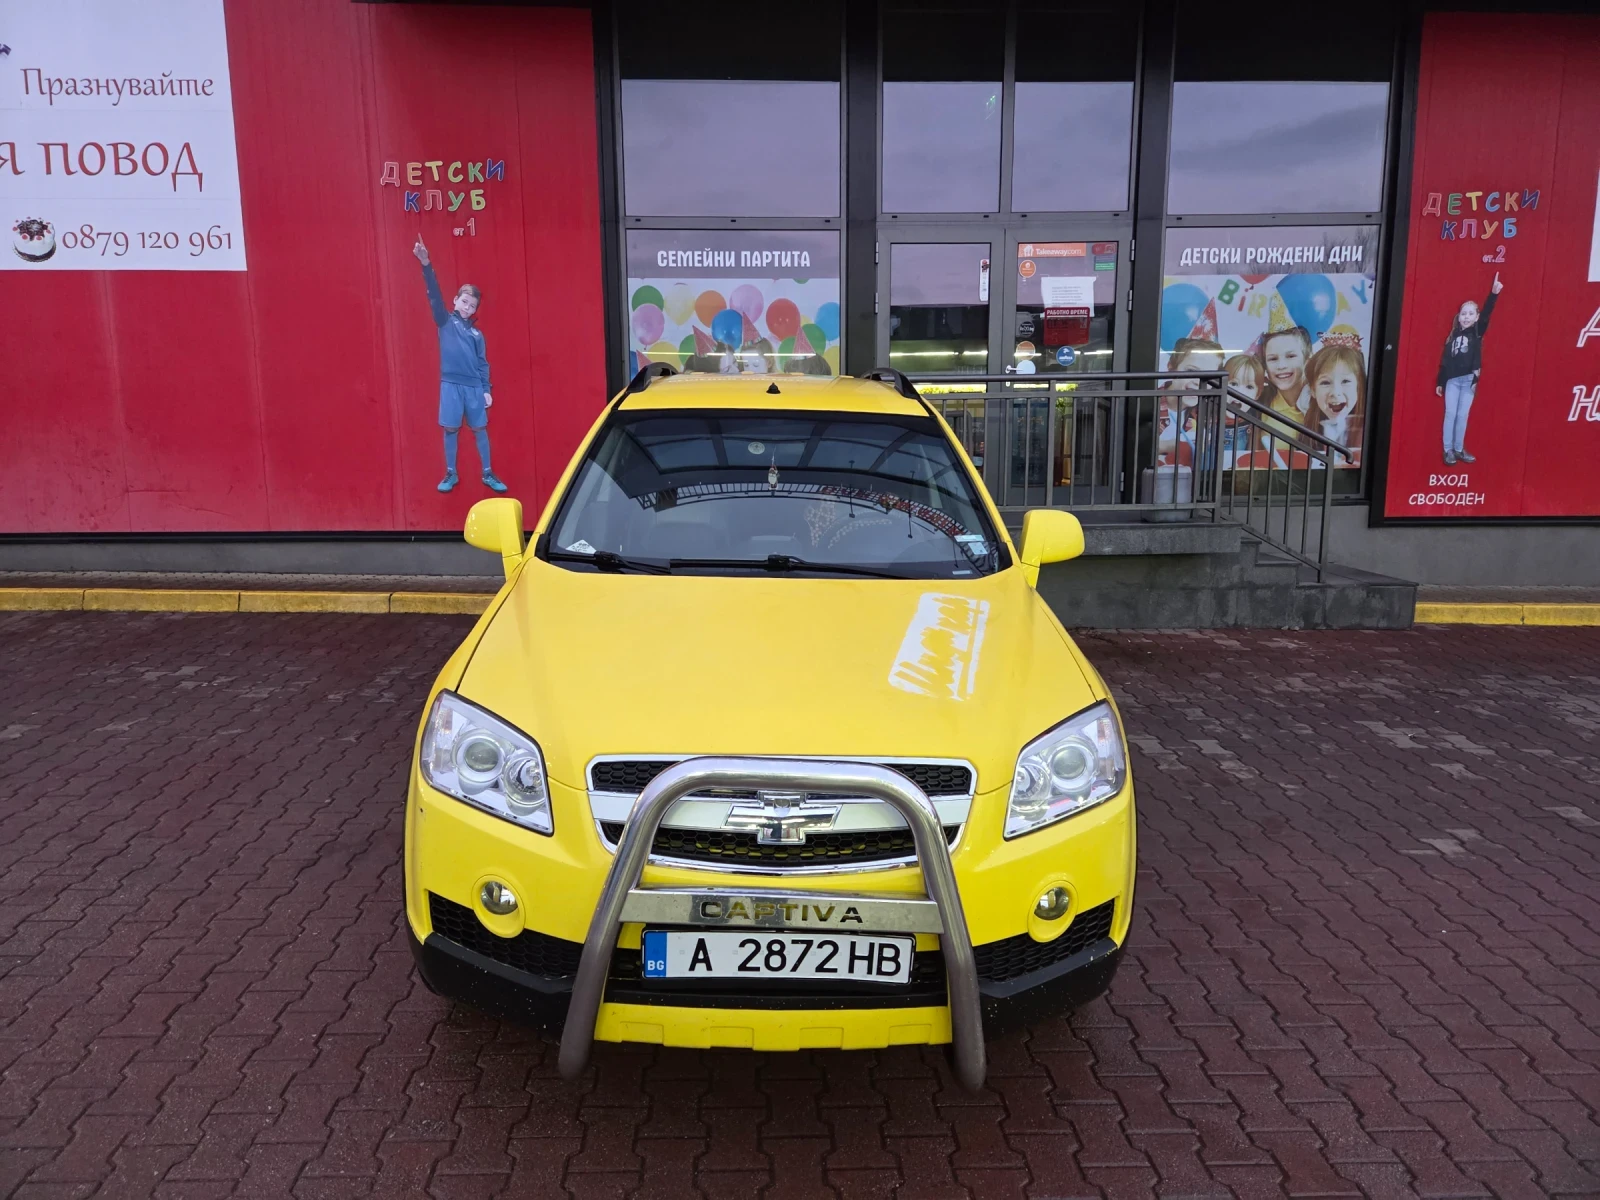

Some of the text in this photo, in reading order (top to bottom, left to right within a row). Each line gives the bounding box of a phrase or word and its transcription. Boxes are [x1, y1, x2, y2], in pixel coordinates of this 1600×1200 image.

[20, 68, 214, 106] Празнувайте
[37, 142, 203, 192] повод
[381, 158, 505, 187] ДЕТСКИ
[404, 189, 486, 212] КЛУБ
[1422, 188, 1540, 217] ДЕТСКИ
[62, 224, 232, 256] 0879 120 961
[1441, 218, 1517, 240] КЛУБ
[657, 248, 810, 267] СЕМЕЙНИ ПАРТИТА
[1180, 246, 1363, 266] ДЕТСКИ РОЖДЕНИ ДНИ
[1429, 474, 1468, 488] ВХОД
[1408, 492, 1485, 506] СВОБОДЕН
[700, 901, 863, 923] CAPTIVA
[647, 960, 665, 971] BG
[688, 937, 713, 972] A
[737, 939, 840, 974] 2872
